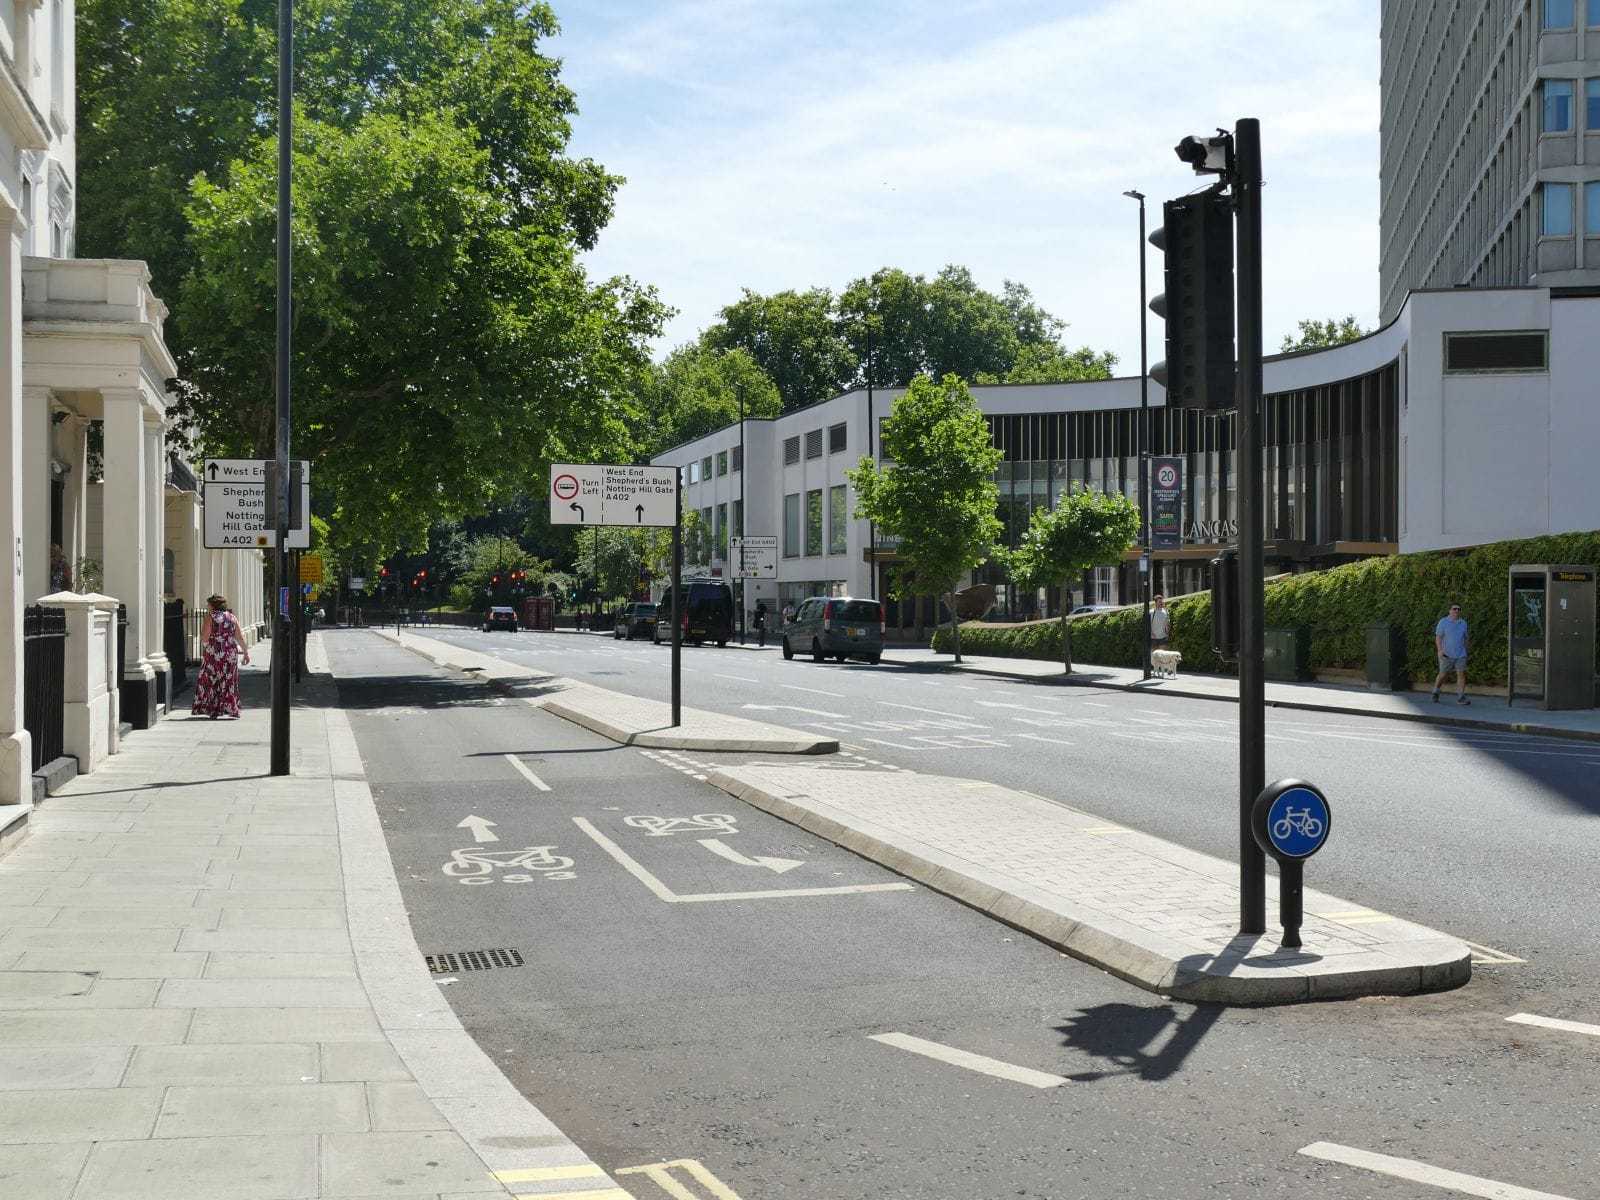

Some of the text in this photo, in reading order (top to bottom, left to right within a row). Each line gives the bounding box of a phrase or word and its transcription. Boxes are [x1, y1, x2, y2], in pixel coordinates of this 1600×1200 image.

[223, 467, 265, 476] West En
[1161, 470, 1174, 482] 20
[606, 477, 650, 485] Shepherd's
[223, 488, 265, 497] Shepher
[582, 487, 599, 495] Left
[606, 486, 636, 494] Notting
[655, 486, 674, 494] Gate
[239, 499, 264, 507] Bush
[226, 511, 265, 521] Notting
[223, 522, 241, 530] Hill
[1182, 519, 1238, 537] LANCAS
[223, 536, 252, 544] A402
[791, 719, 993, 732] TURN
[862, 733, 1075, 750] LEFT
[459, 871, 578, 885] CS3
